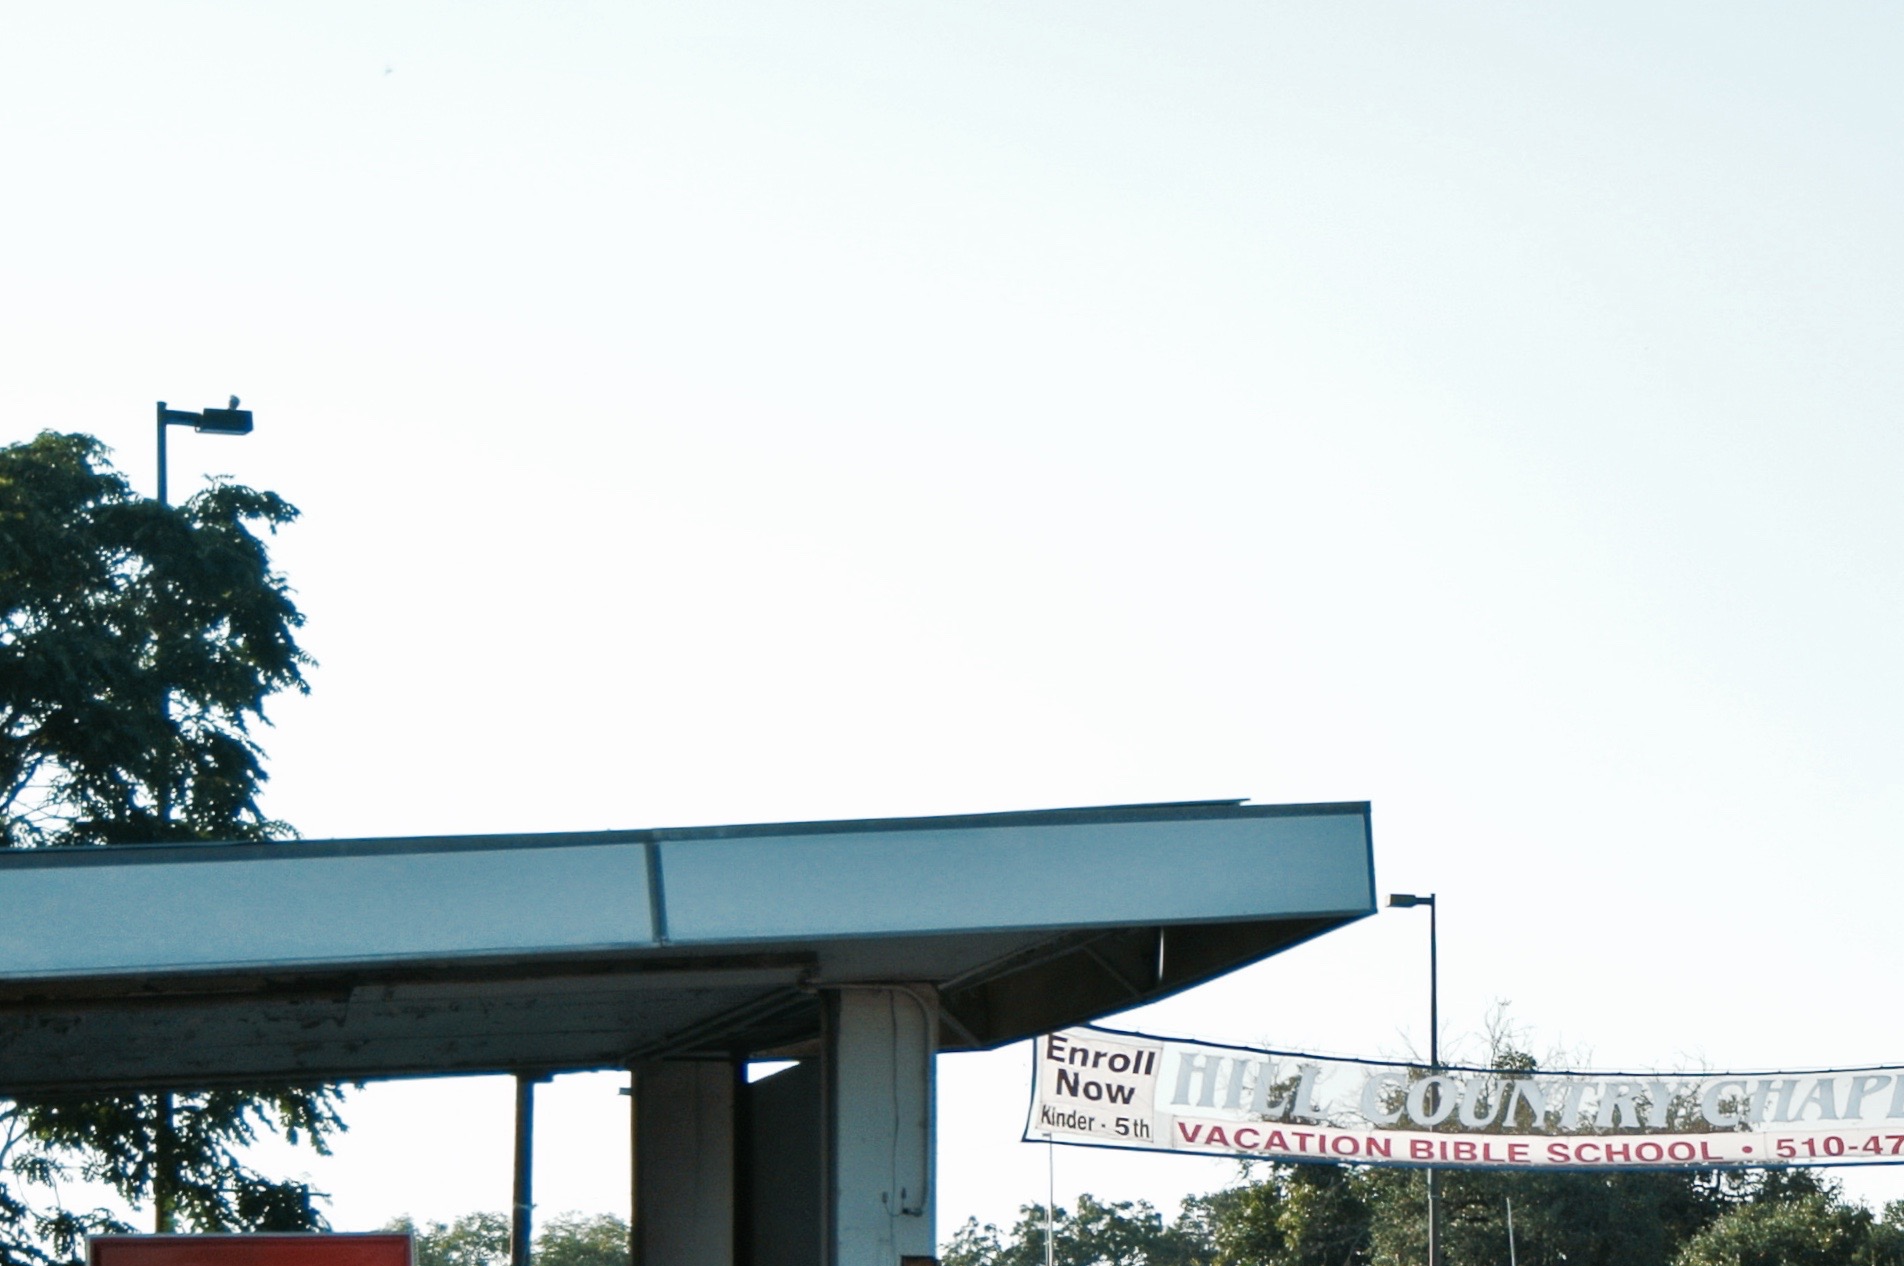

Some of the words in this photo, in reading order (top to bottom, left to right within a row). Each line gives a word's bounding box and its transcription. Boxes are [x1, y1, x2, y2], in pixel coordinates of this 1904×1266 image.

[1046, 1033, 1156, 1075] Enroll
[1056, 1068, 1135, 1105] Now
[1171, 1052, 1334, 1121] HILL
[1360, 1072, 1692, 1129] COUNTRY
[1041, 1104, 1096, 1131] Kinder
[1115, 1117, 1151, 1138] 5th
[1178, 1121, 1392, 1158] VACATION
[1410, 1139, 1532, 1163] BIBLE
[1547, 1142, 1723, 1163] SCHOOL
